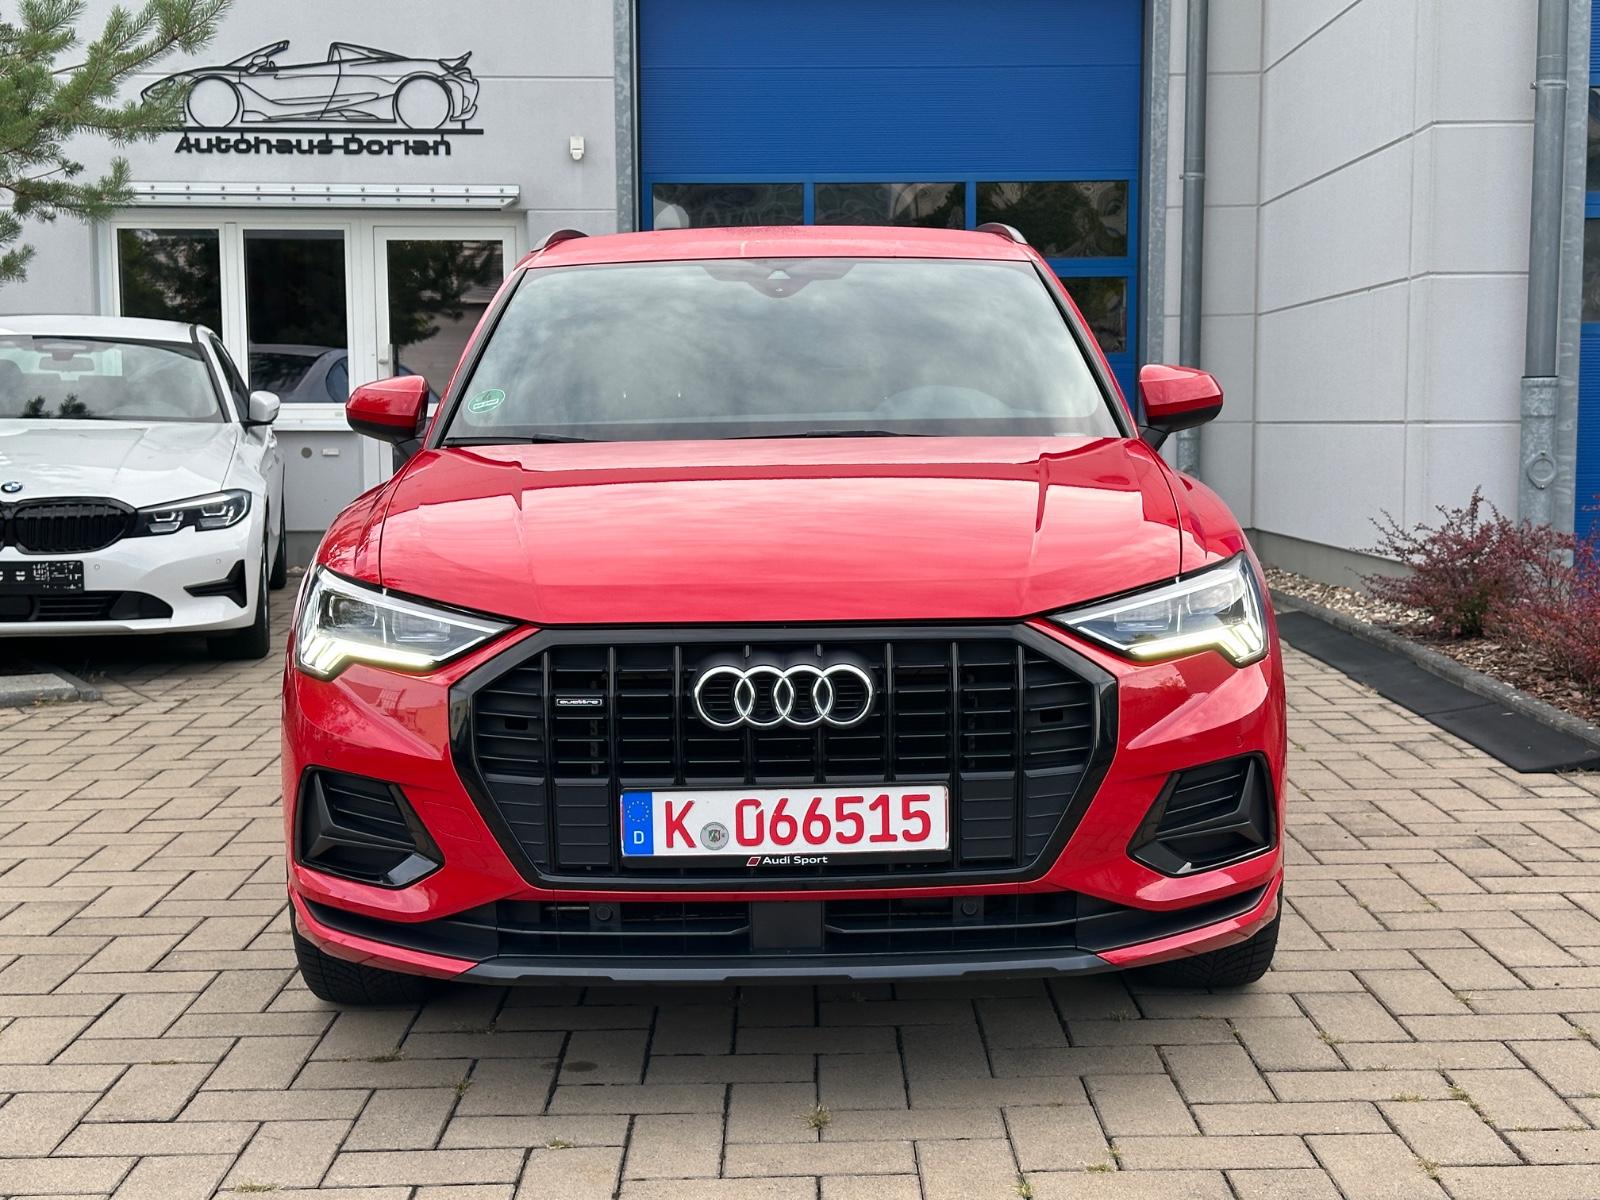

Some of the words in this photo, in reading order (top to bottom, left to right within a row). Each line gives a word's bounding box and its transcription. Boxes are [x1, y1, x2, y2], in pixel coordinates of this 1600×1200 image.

[633, 830, 645, 845] D
[664, 800, 697, 849] K
[735, 794, 932, 847] 066515
[762, 856, 790, 864] Audi
[793, 855, 828, 866] Sport
